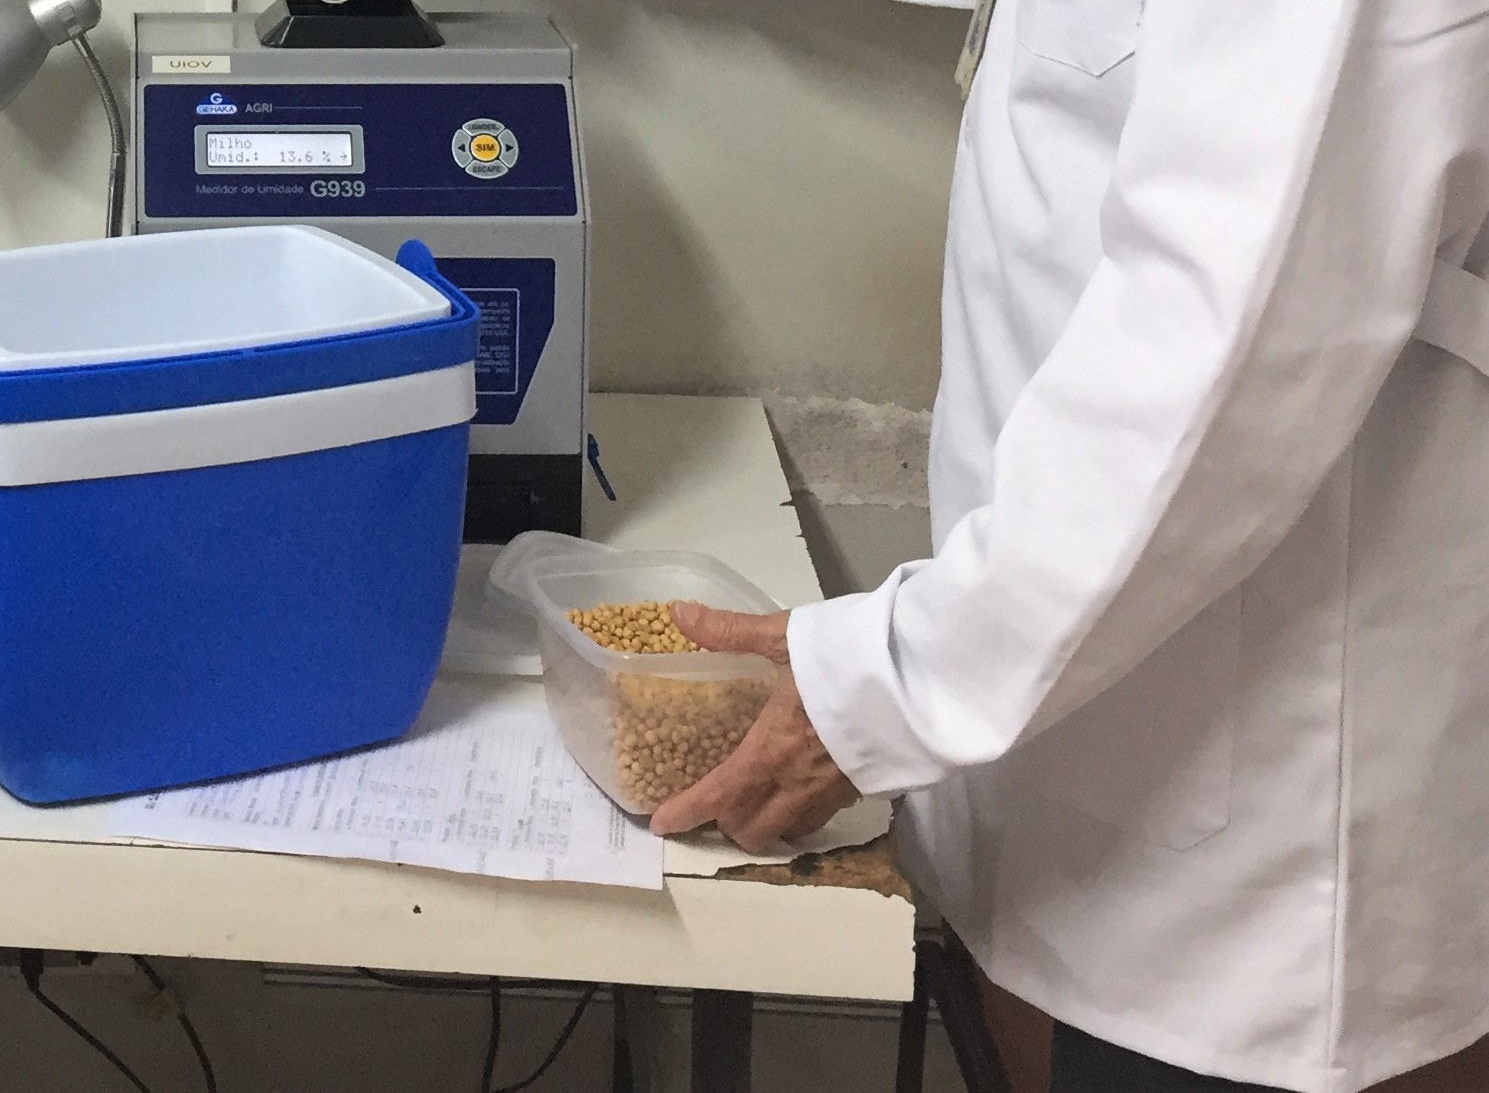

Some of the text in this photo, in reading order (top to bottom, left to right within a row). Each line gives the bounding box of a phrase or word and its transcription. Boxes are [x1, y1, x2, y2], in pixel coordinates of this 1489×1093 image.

[210, 93, 223, 104] G
[245, 103, 272, 113] AGRI
[209, 138, 252, 149] Milho
[280, 151, 313, 163] 13.6
[322, 151, 331, 163] %
[196, 180, 366, 198] Medidor de Umidade G939
